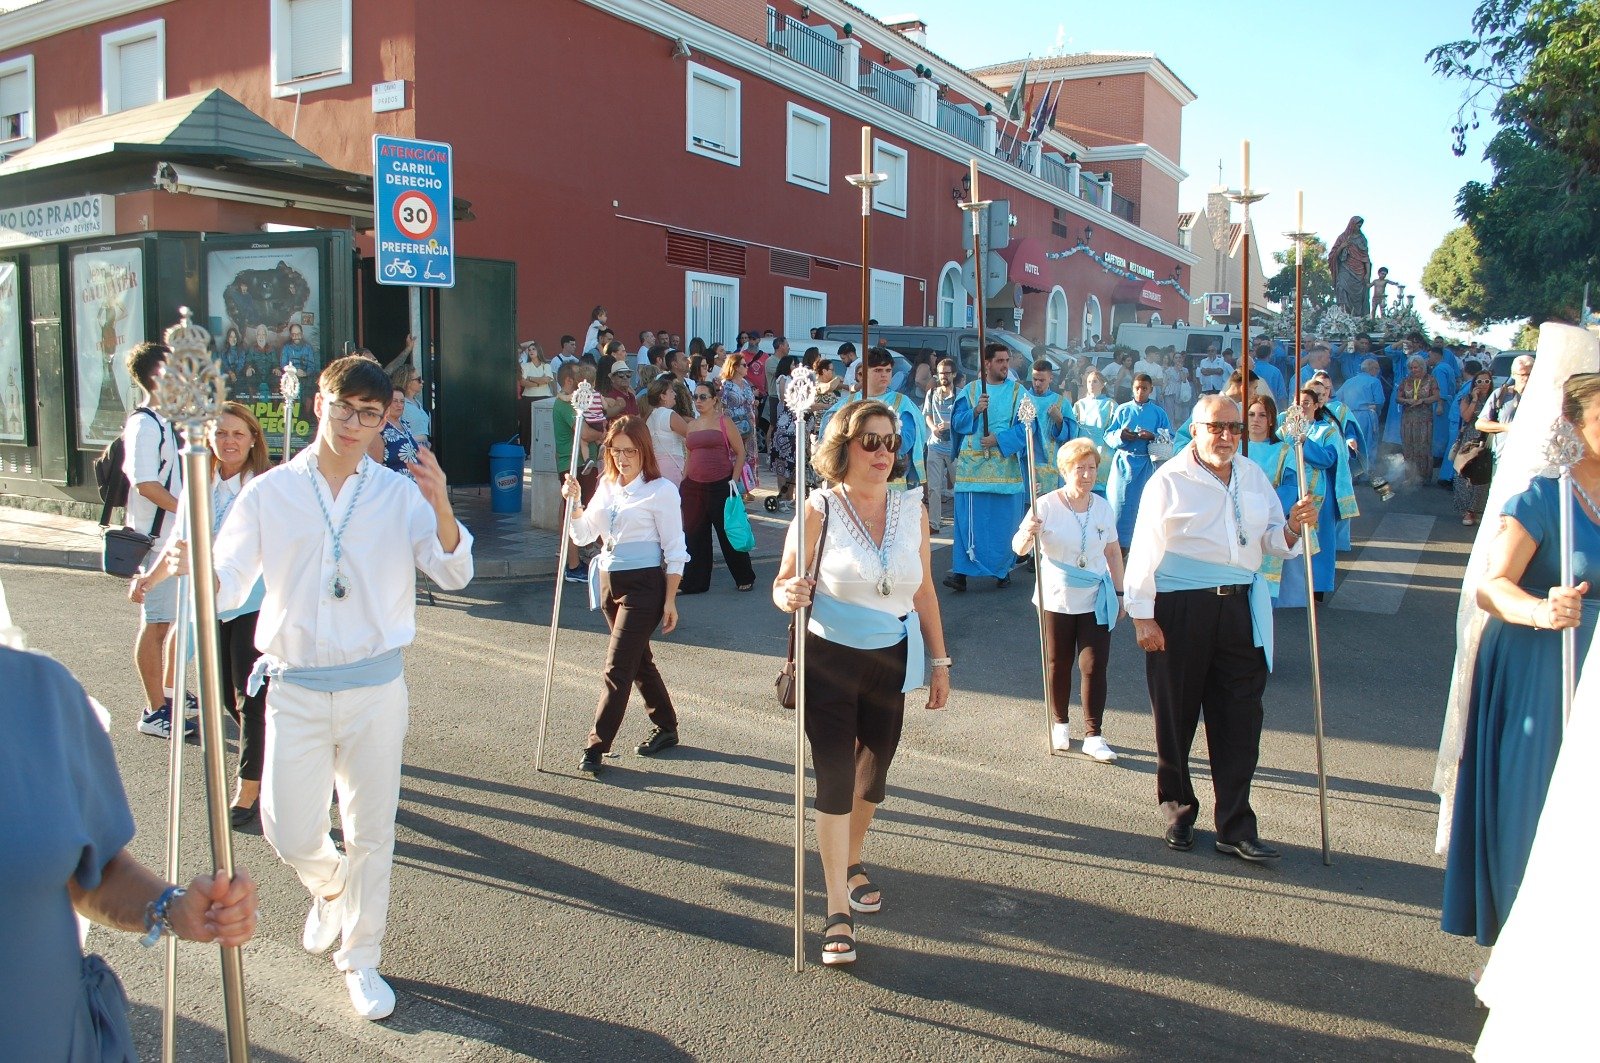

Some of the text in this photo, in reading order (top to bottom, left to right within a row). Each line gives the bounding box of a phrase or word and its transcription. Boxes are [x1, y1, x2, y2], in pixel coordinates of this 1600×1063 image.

[380, 144, 448, 164] ATENCIÓN
[392, 160, 436, 176] CARRIL
[385, 173, 442, 190] DERECHO
[20, 207, 43, 228] LOS
[47, 198, 100, 224] PRADOS
[403, 206, 428, 224] 30
[74, 221, 101, 233] REVISTAS
[381, 241, 449, 256] PREFERENCIA
[1024, 262, 1040, 276] HOTEL
[1129, 261, 1155, 279] RESTAURANTE
[1211, 295, 1224, 309] P
[255, 402, 300, 417] PLAN
[258, 418, 310, 435] FECTO
